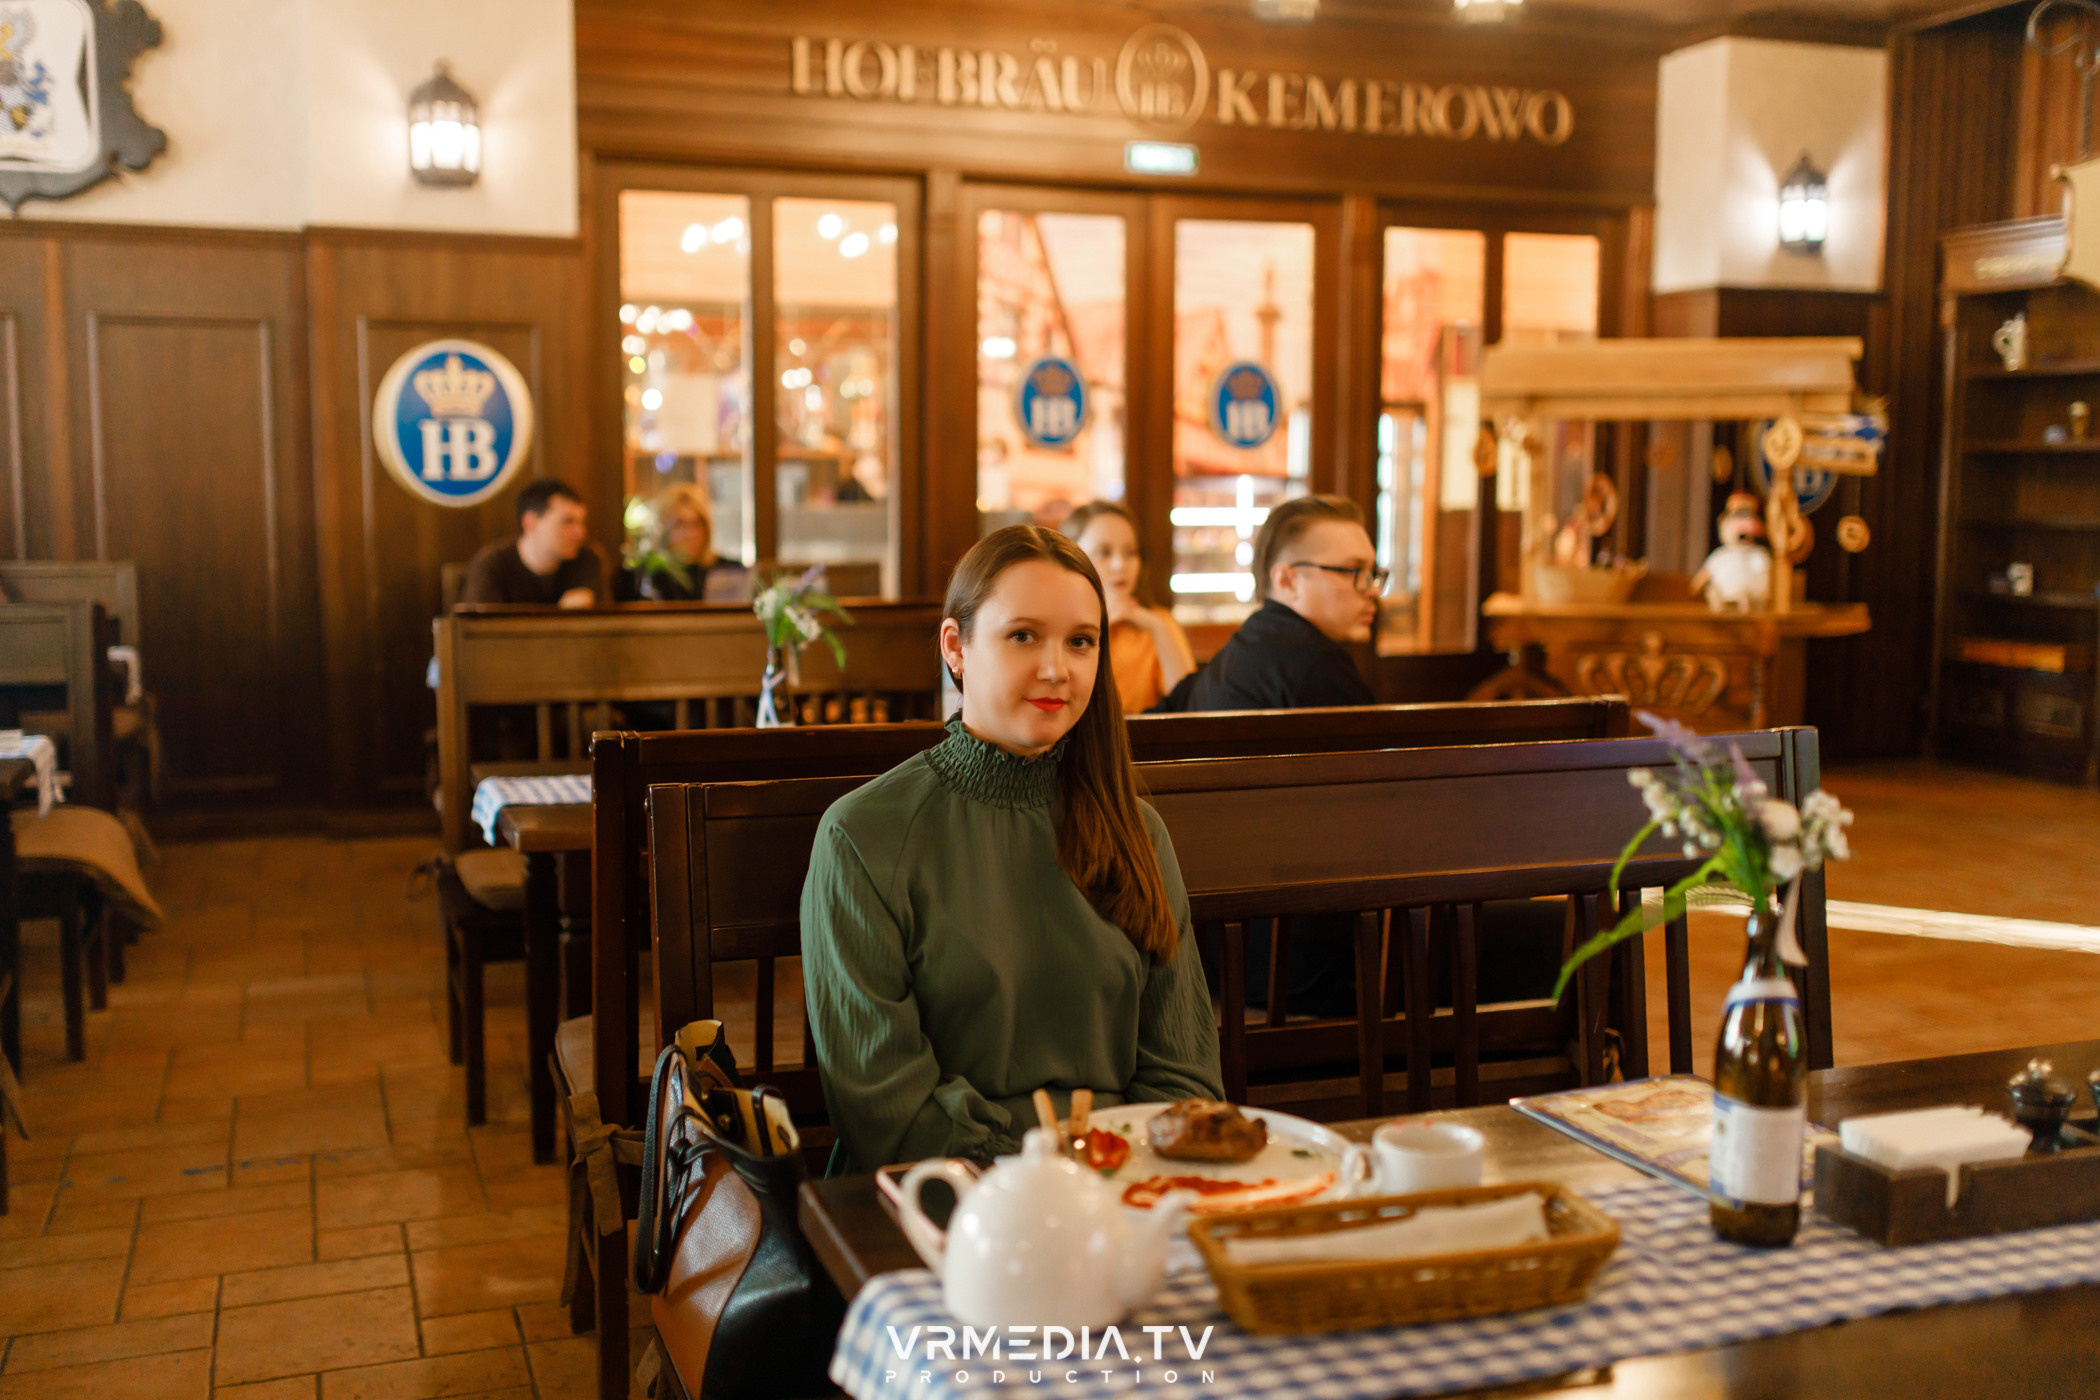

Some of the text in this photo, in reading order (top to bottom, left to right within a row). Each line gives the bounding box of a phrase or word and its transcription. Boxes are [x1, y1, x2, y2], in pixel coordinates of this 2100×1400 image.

[791, 36, 1107, 112] HOFBRÄU
[1217, 68, 1575, 147] KEMEROWO
[418, 418, 499, 481] HB
